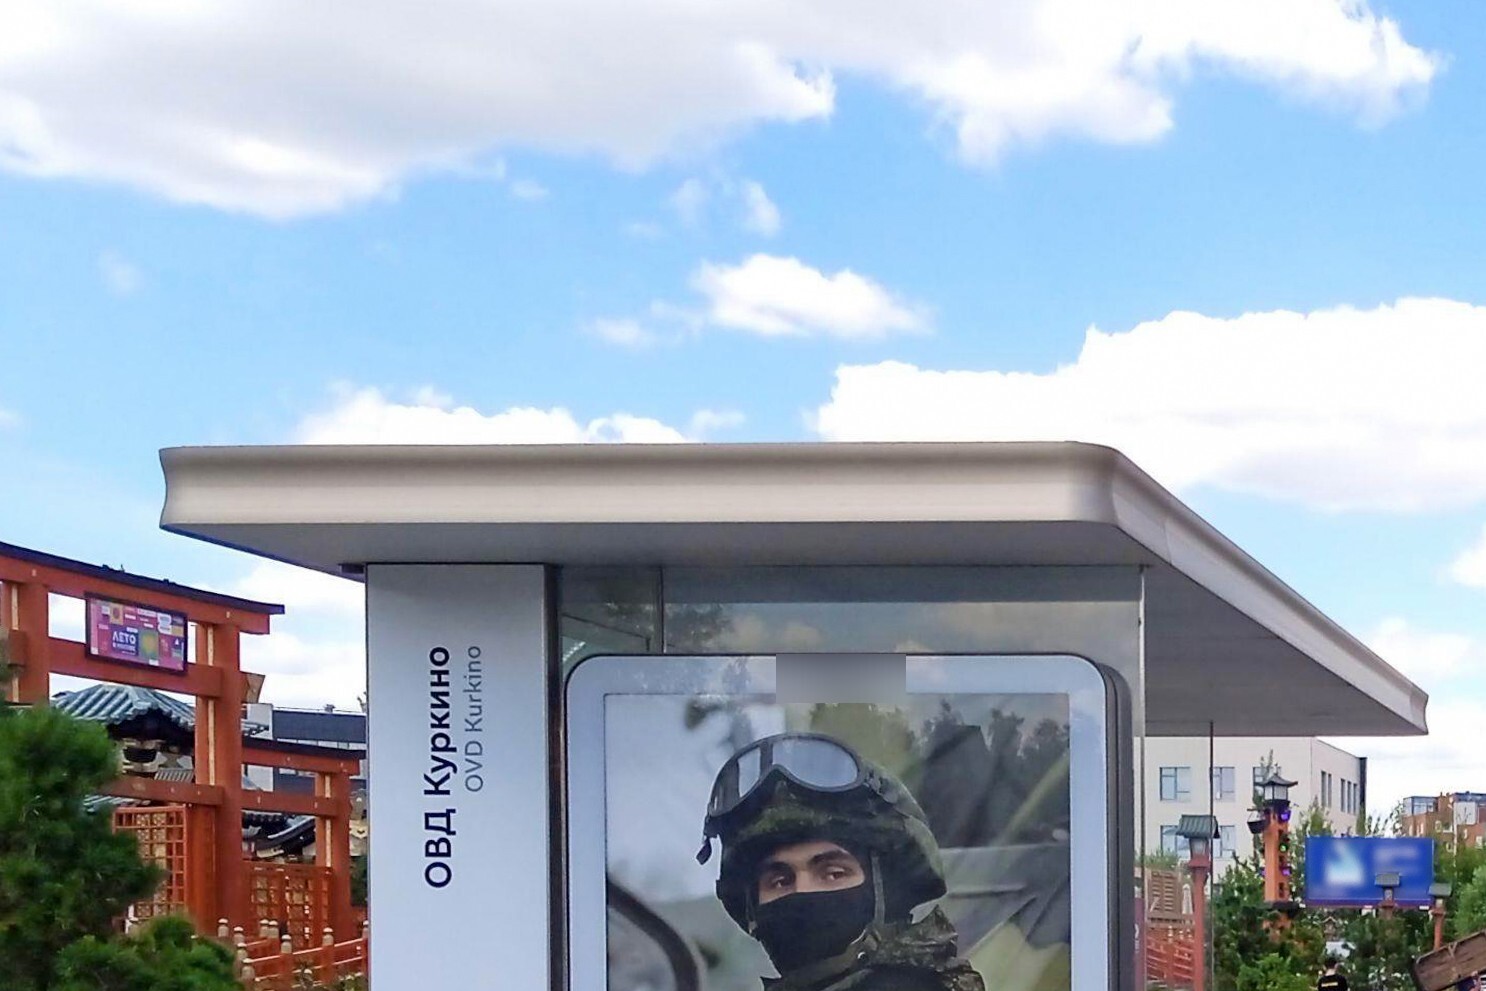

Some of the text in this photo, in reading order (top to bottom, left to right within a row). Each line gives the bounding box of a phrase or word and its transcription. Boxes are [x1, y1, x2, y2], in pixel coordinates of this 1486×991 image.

[423, 646, 458, 888] ОВД Куркино
[463, 646, 484, 793] OVD Kurkino
